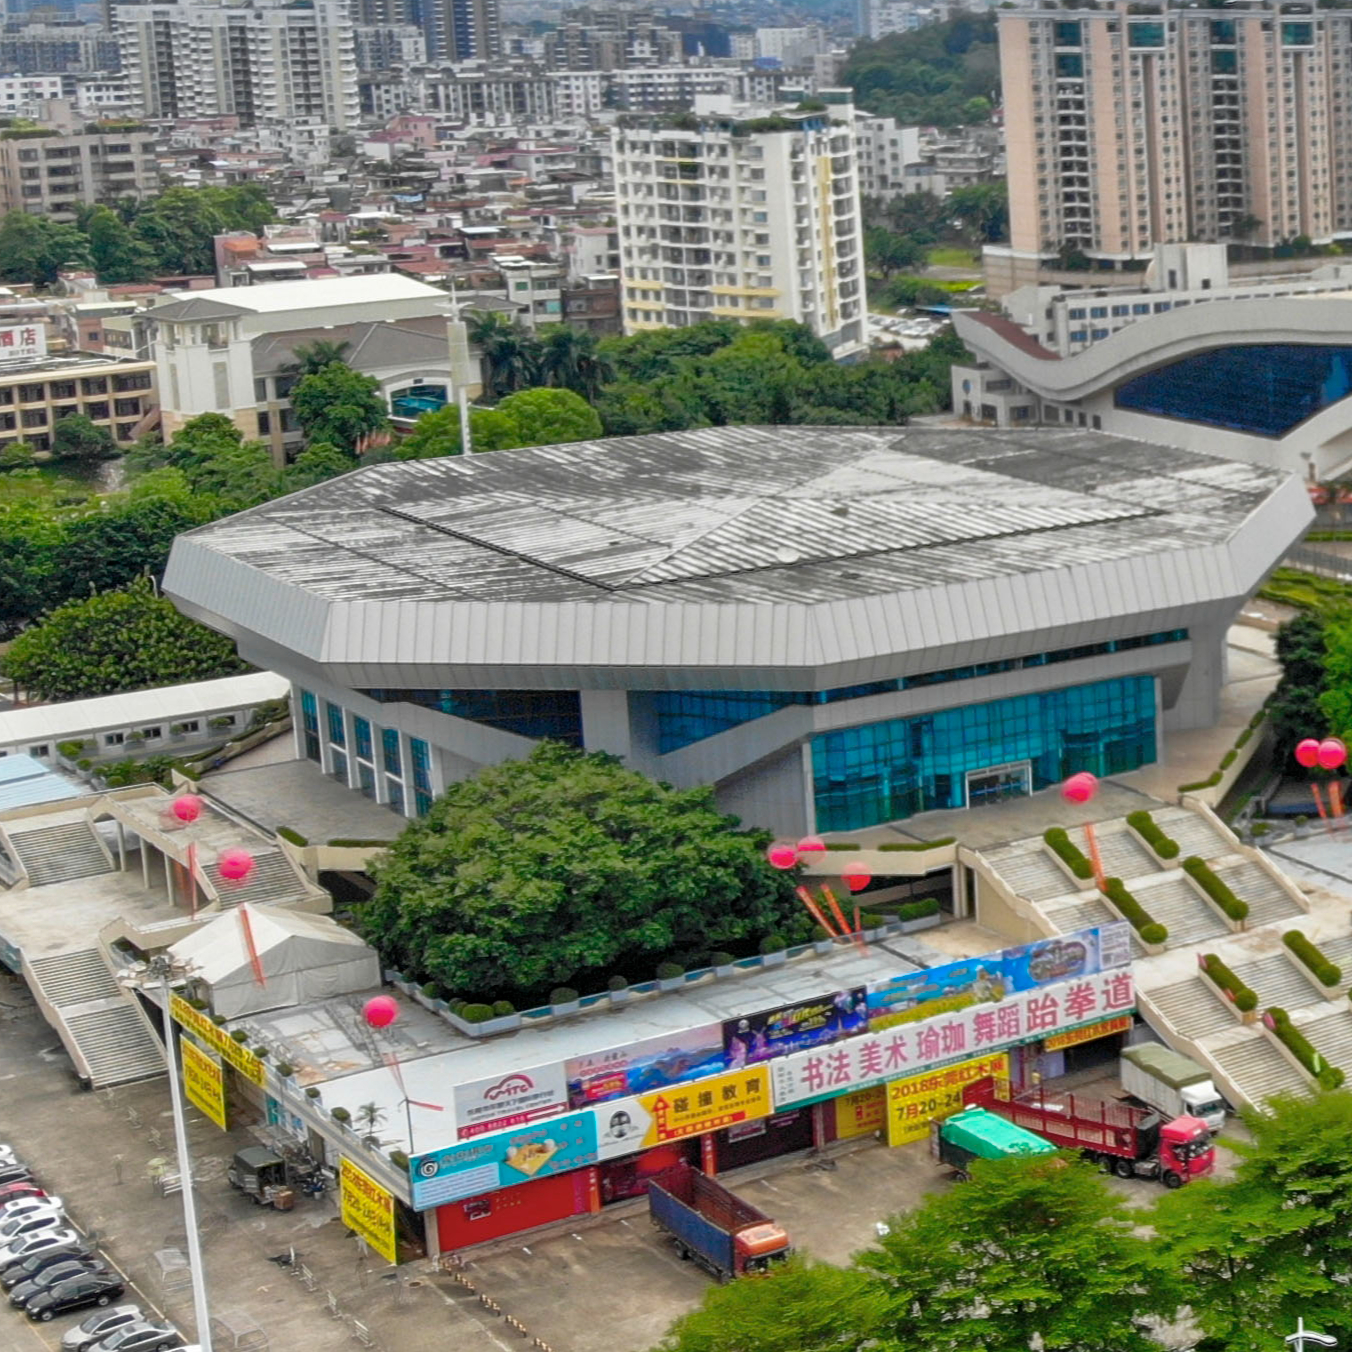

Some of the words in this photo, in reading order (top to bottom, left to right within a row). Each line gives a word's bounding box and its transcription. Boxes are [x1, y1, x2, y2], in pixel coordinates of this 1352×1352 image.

[801, 1050, 851, 1092] 书法
[859, 1036, 908, 1079] 美术
[973, 1003, 1020, 1047] 舞蹈
[1026, 973, 1134, 1032] 跆拳道
[673, 1078, 760, 1113] 碰撞教育
